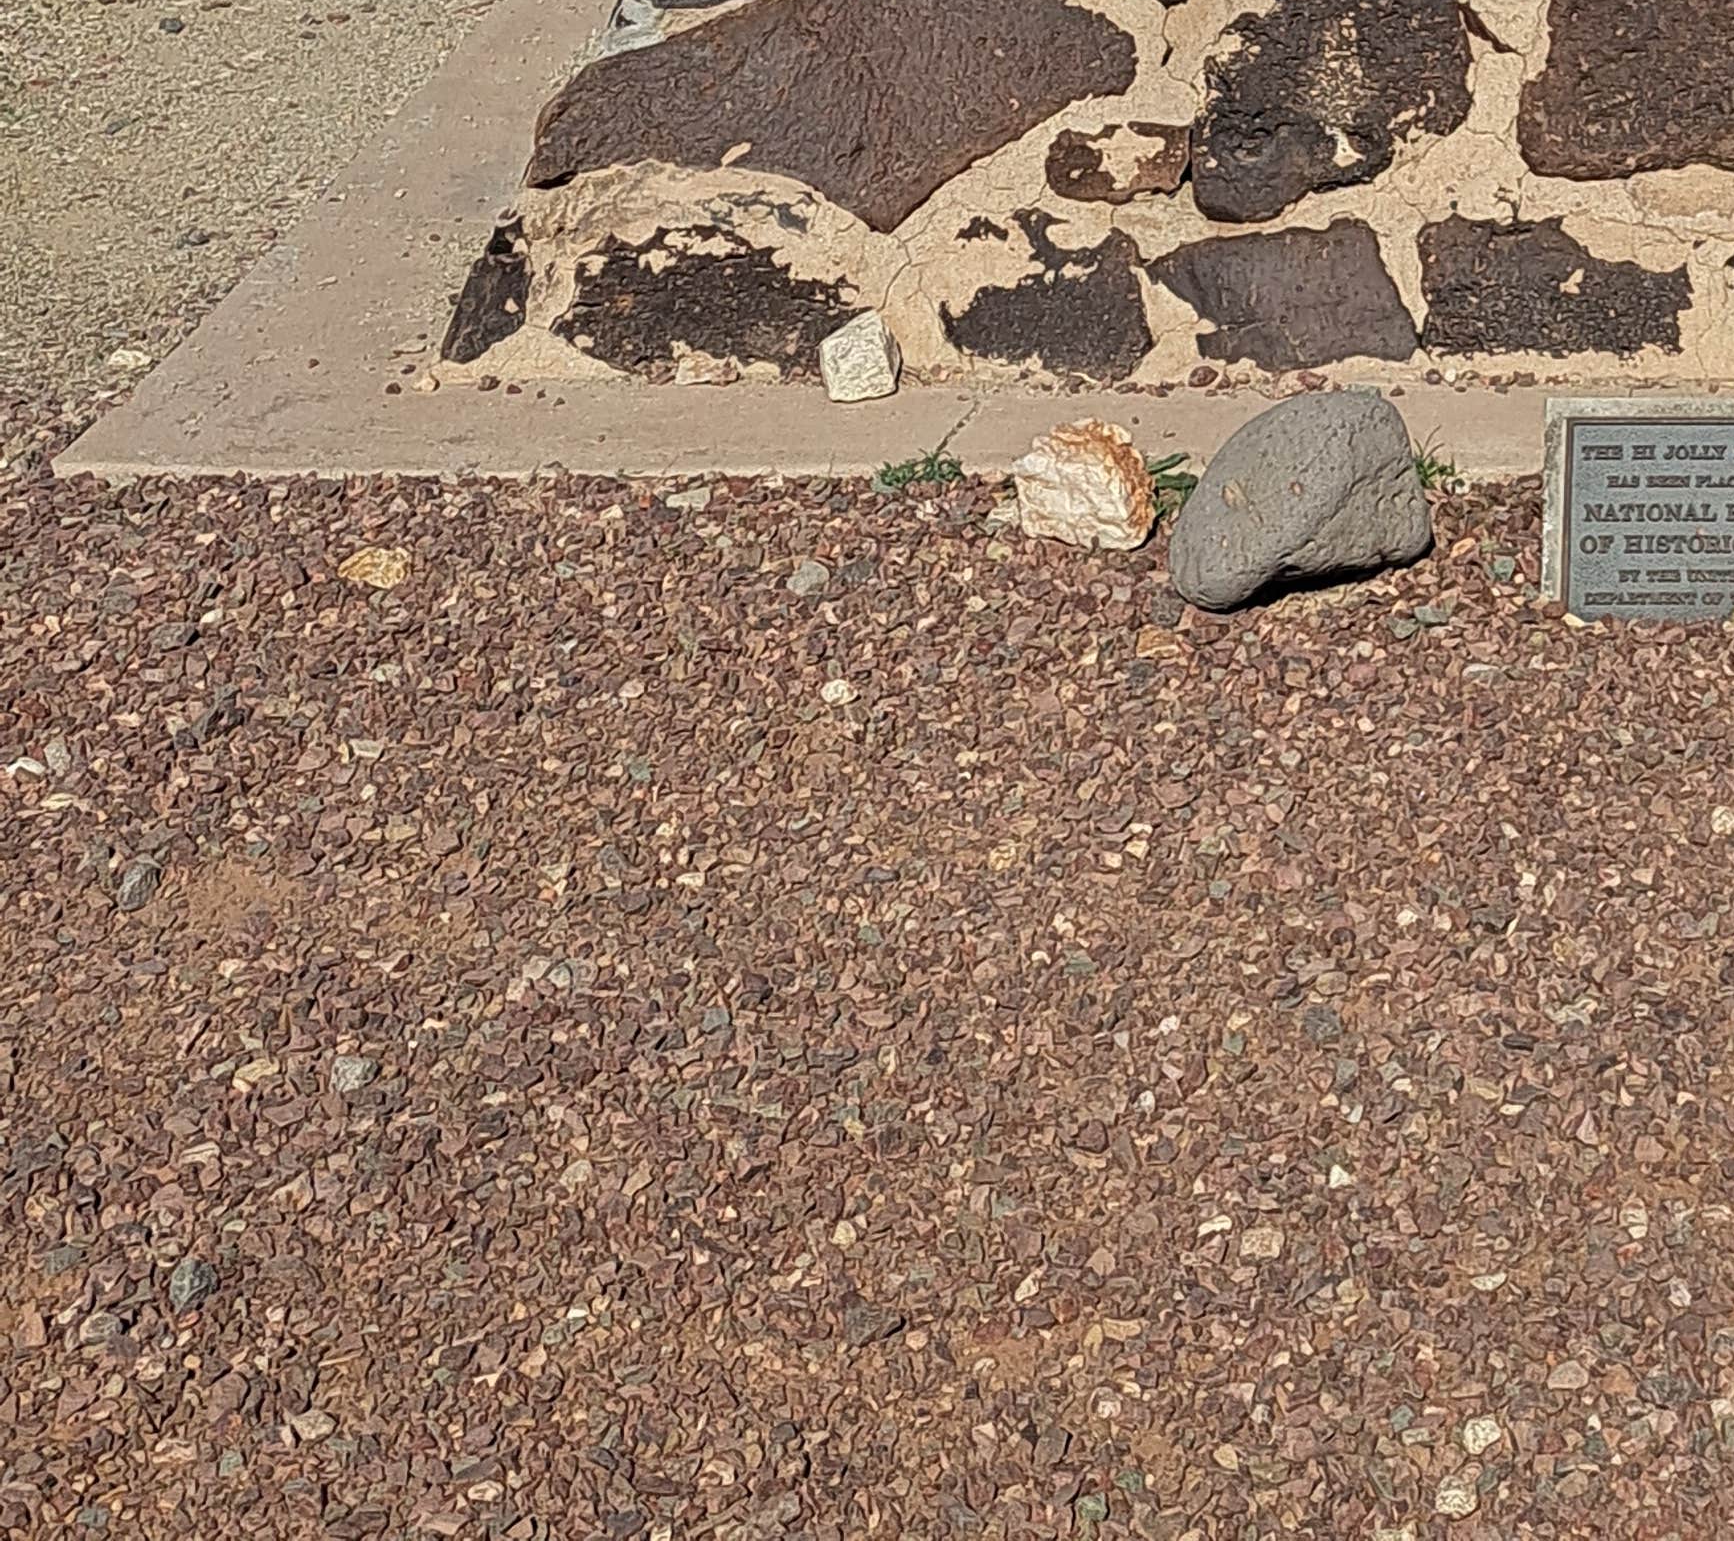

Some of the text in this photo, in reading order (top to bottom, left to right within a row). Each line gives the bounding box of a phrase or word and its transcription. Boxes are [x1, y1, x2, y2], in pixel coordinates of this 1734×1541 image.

[1582, 445, 1623, 460] THE
[1632, 445, 1656, 460] HI
[1663, 445, 1726, 460] JOLLY
[1606, 476, 1640, 488] HAS
[1646, 476, 1690, 488] BEEN
[1584, 504, 1716, 522] NATIONAL
[1580, 535, 1614, 554] OF
[1618, 570, 1643, 582] BY
[1646, 570, 1680, 582] THE
[1584, 592, 1697, 605] DEPARTMENT
[1702, 592, 1724, 605] OF
